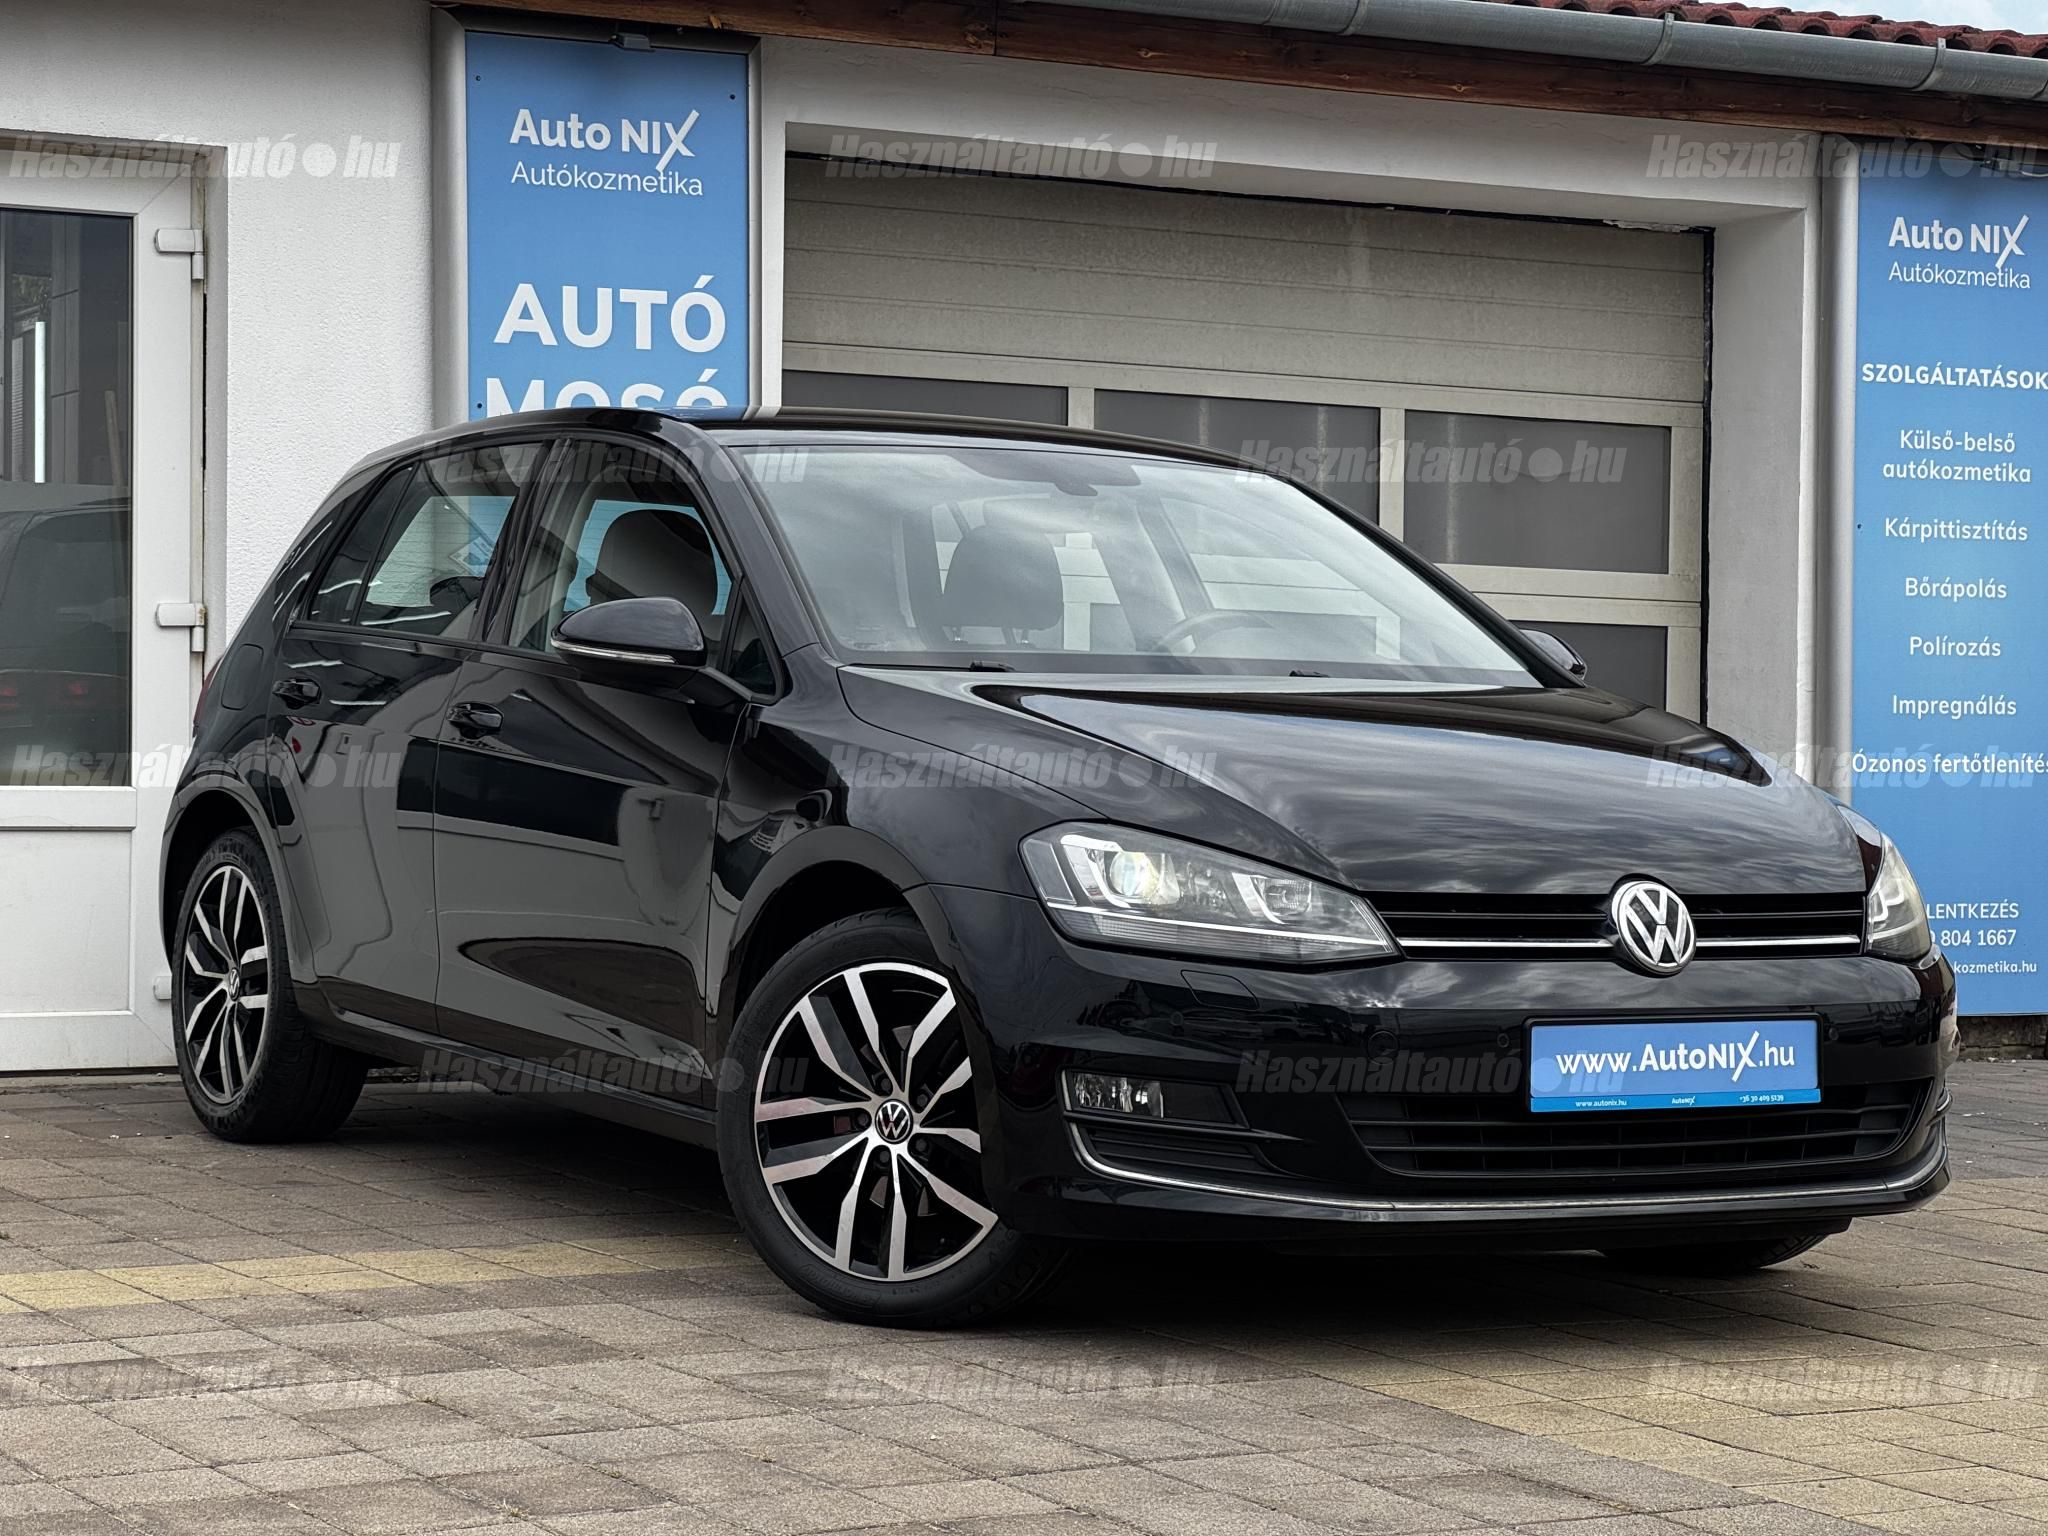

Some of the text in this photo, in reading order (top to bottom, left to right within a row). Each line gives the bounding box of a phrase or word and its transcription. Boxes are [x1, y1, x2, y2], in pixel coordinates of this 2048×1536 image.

[509, 108, 700, 172] Auto NIX
[511, 160, 703, 196] Autókozmetika
[1888, 214, 2030, 268] Auto NIX
[1888, 261, 2031, 289] Autókozmetika
[493, 274, 726, 353] AUTÓ
[1862, 361, 2048, 390] SZOLGÁLTATÁSOK
[1900, 429, 2016, 453] Külső-belső
[1882, 458, 2031, 483] autókozmetika
[1885, 516, 2029, 543] Kárpittisztítás
[1905, 576, 2007, 602] Bőrápolás
[1909, 635, 2001, 657] Polírozás
[1892, 694, 2017, 720] Impregnálás
[1852, 748, 2048, 773] Ózonos fertőtleníté
[1940, 930, 1971, 946] 804
[1977, 929, 2016, 946] 1667
[1555, 1030, 1795, 1082] www.AutoNIX.hu
[1575, 1098, 1627, 1107] www.autonix.hu
